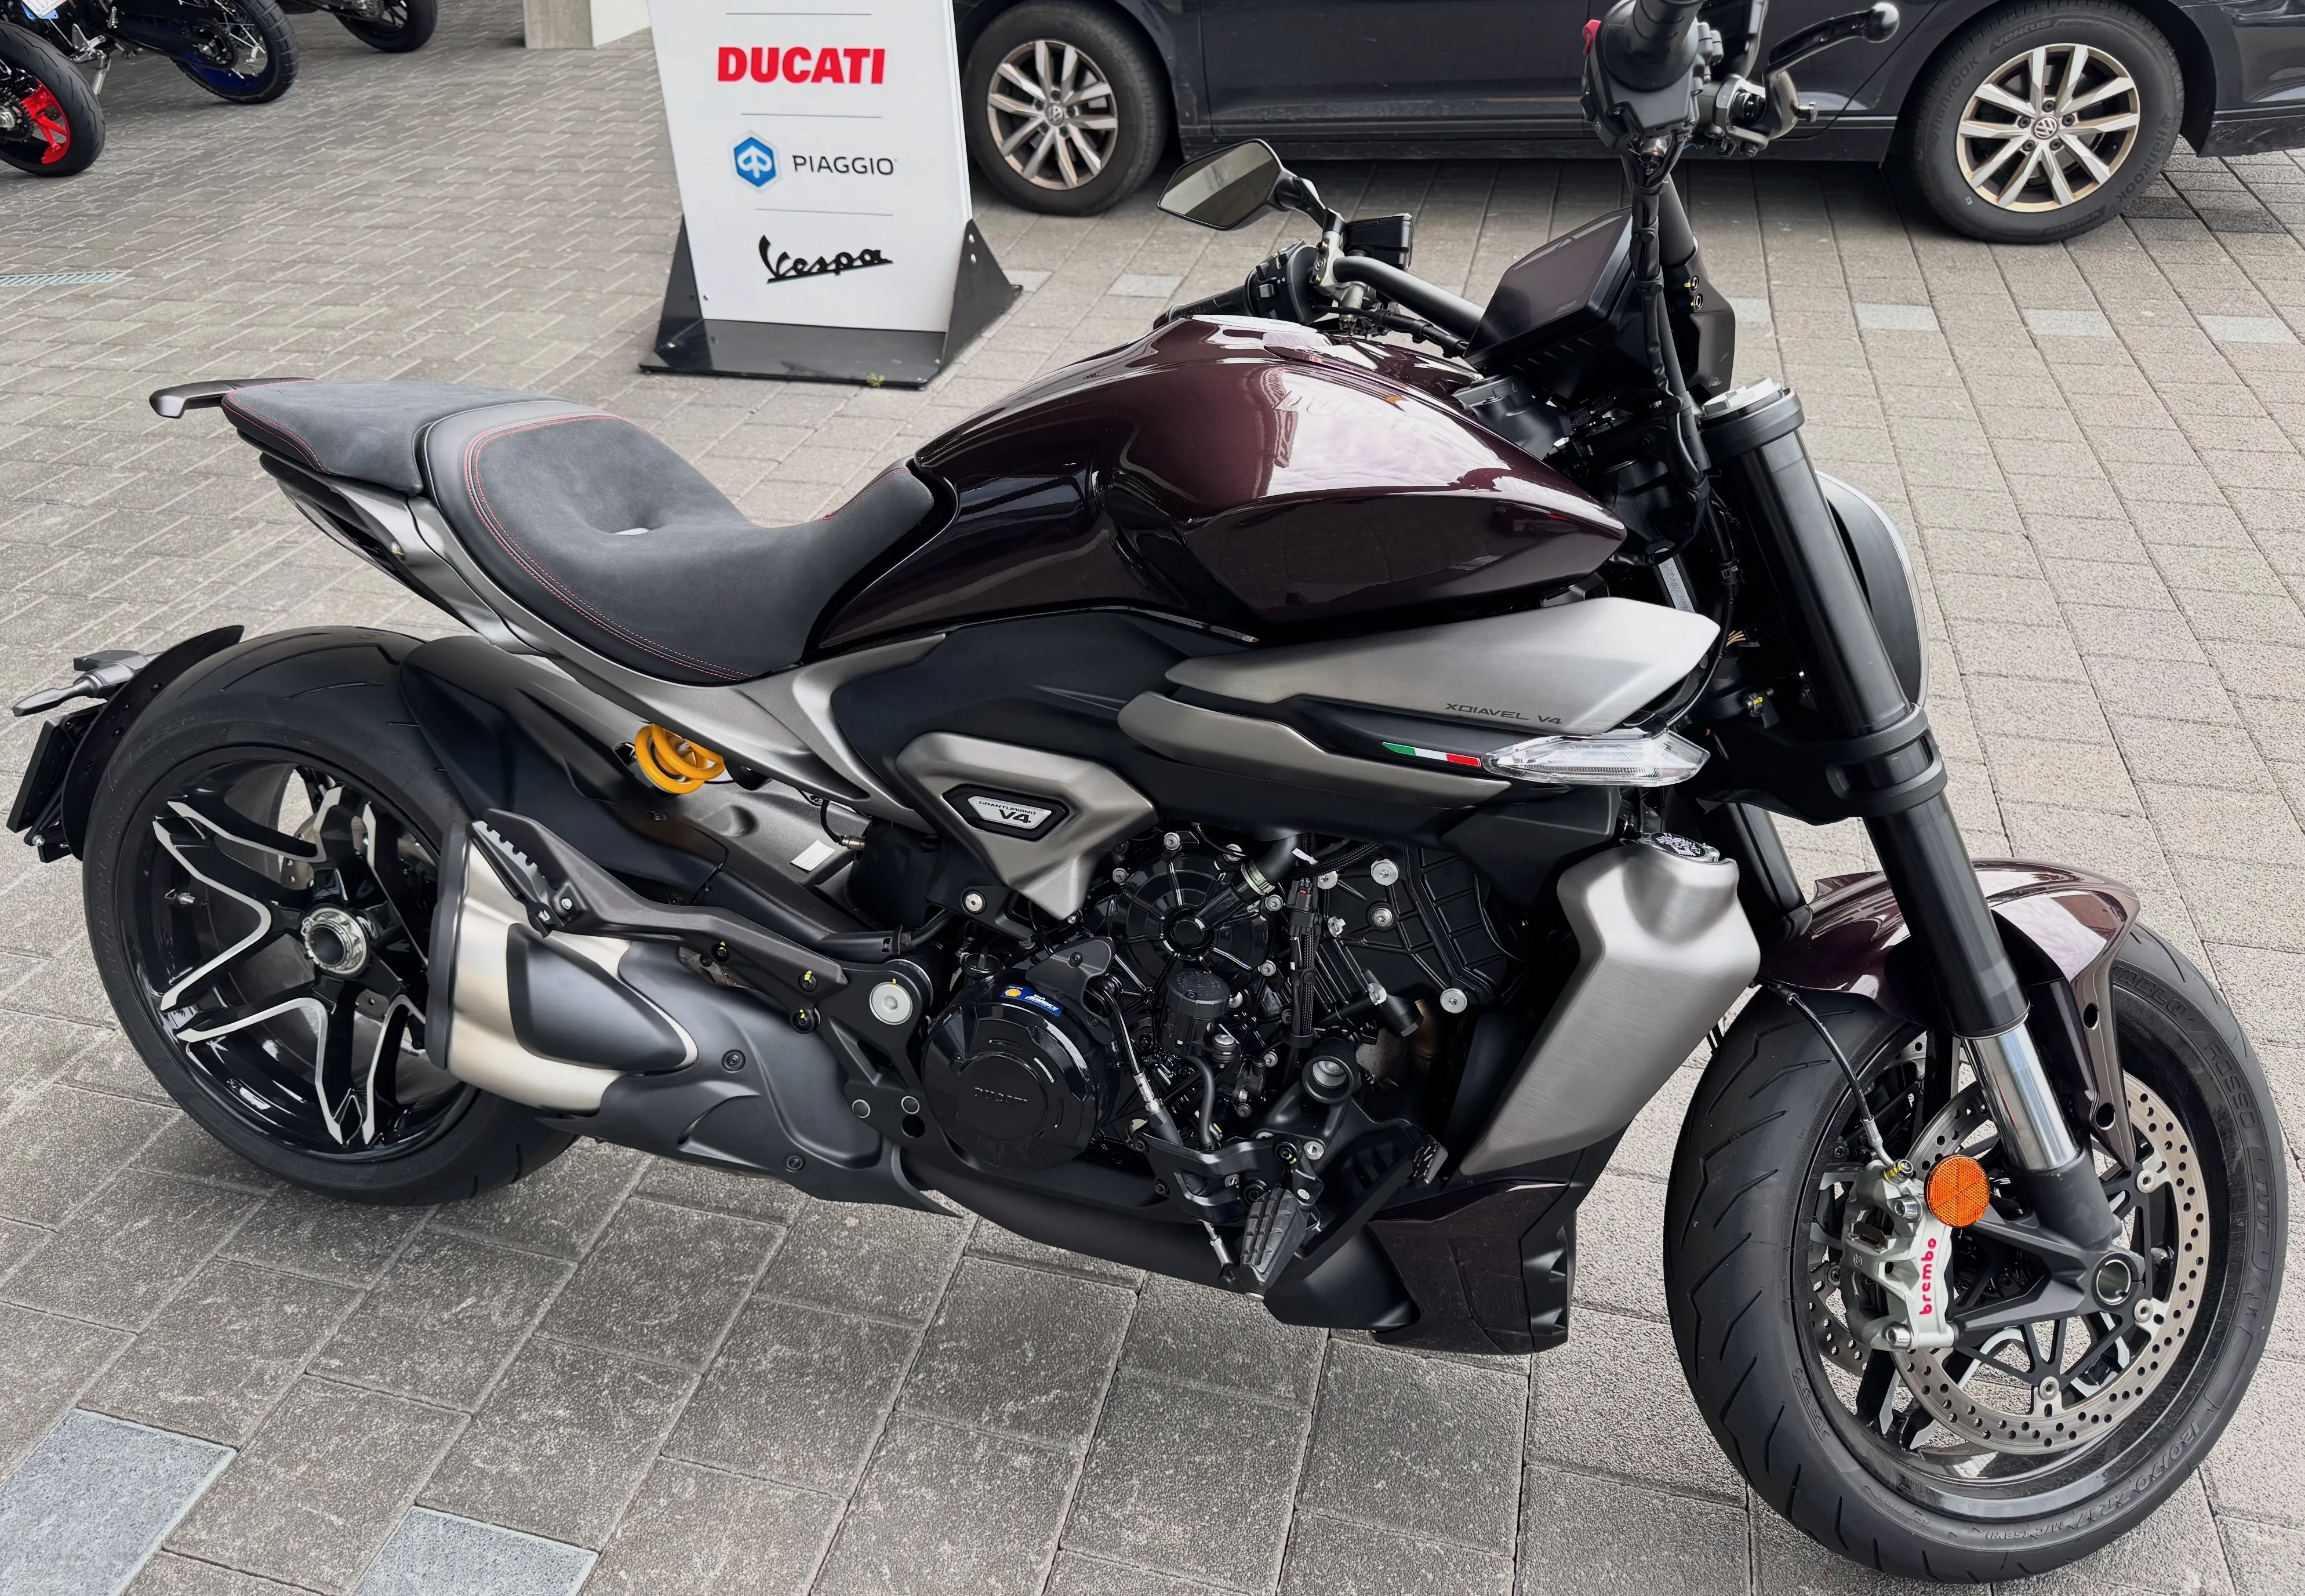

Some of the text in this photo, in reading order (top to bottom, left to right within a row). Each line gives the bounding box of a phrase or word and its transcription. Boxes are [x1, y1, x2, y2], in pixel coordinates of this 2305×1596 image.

[717, 46, 886, 85] DUCATI
[792, 154, 895, 176] PIAGGIO
[758, 234, 894, 284] Vespa
[1445, 702, 1562, 725] XDIAVEL V4
[979, 800, 1037, 815] GRANTURISMO
[999, 809, 1031, 824] V4
[1919, 1238, 1937, 1315] brembo
